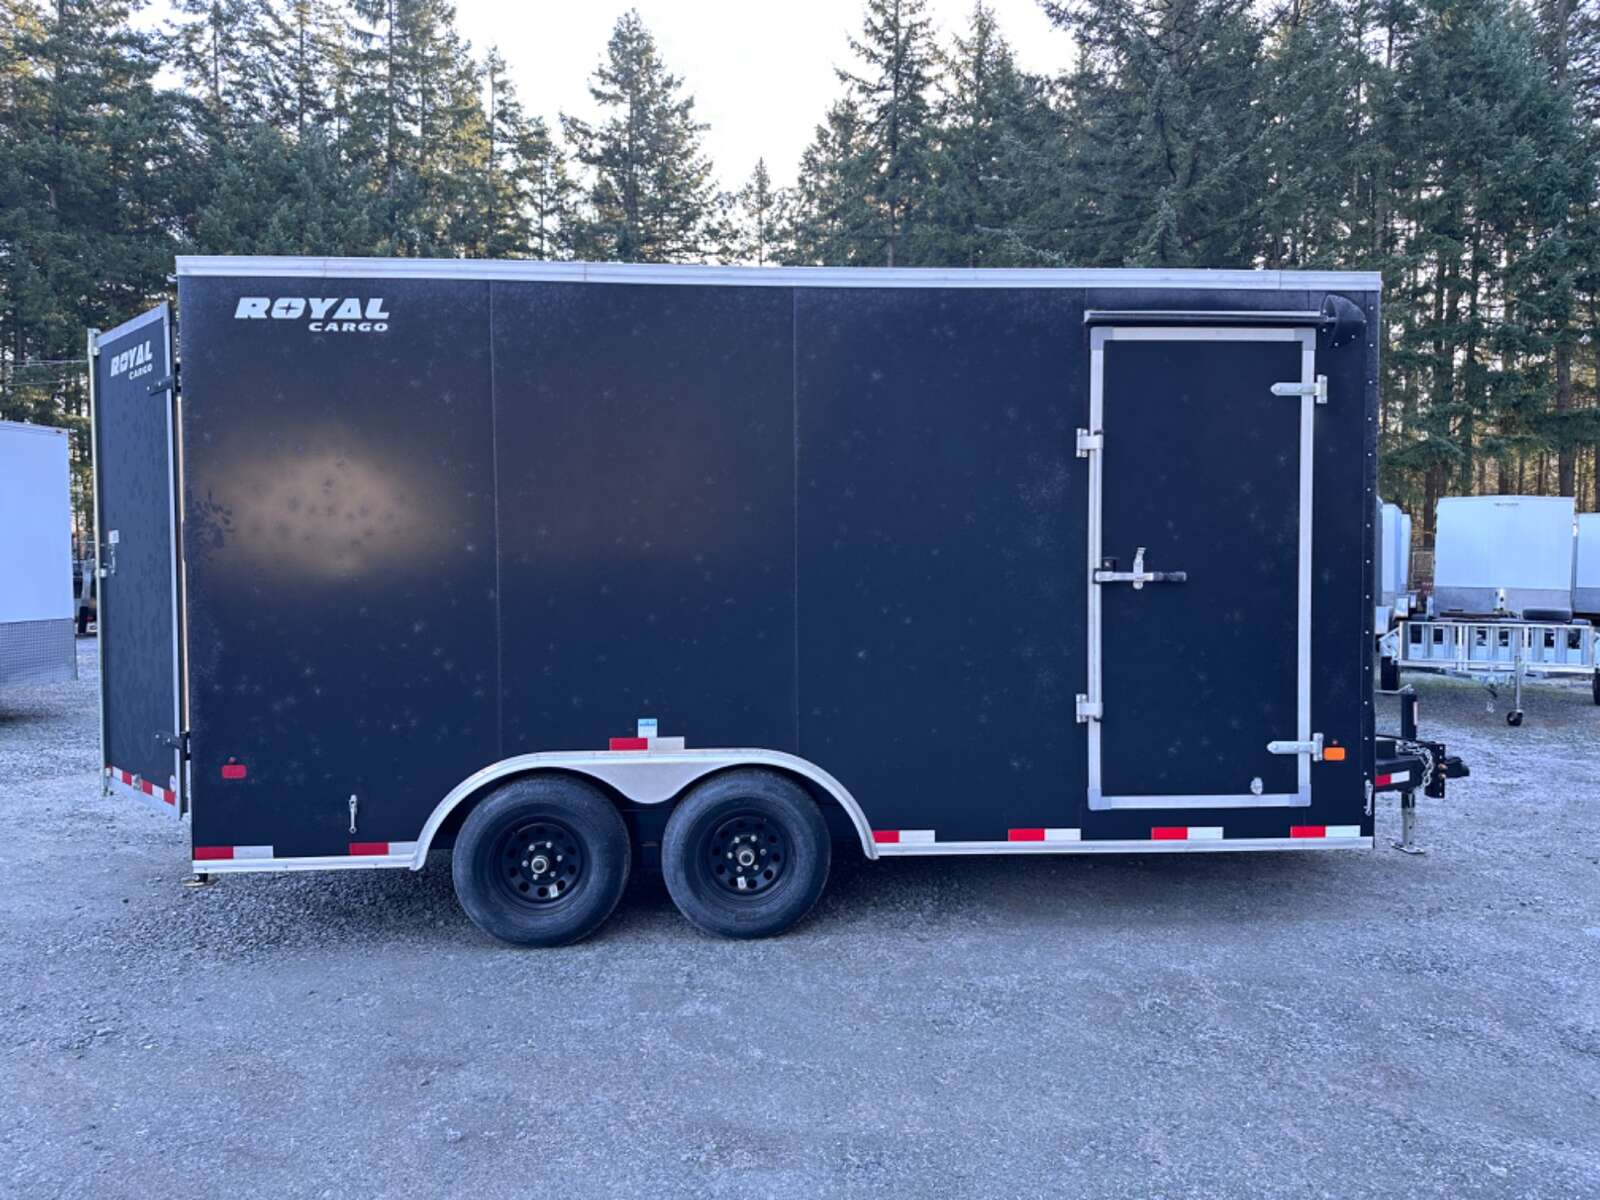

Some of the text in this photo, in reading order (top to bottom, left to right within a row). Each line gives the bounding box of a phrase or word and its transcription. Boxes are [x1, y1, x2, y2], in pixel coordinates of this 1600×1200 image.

[234, 297, 390, 319] ROYAL
[308, 322, 389, 332] CARGO
[110, 340, 153, 377] ROYAL
